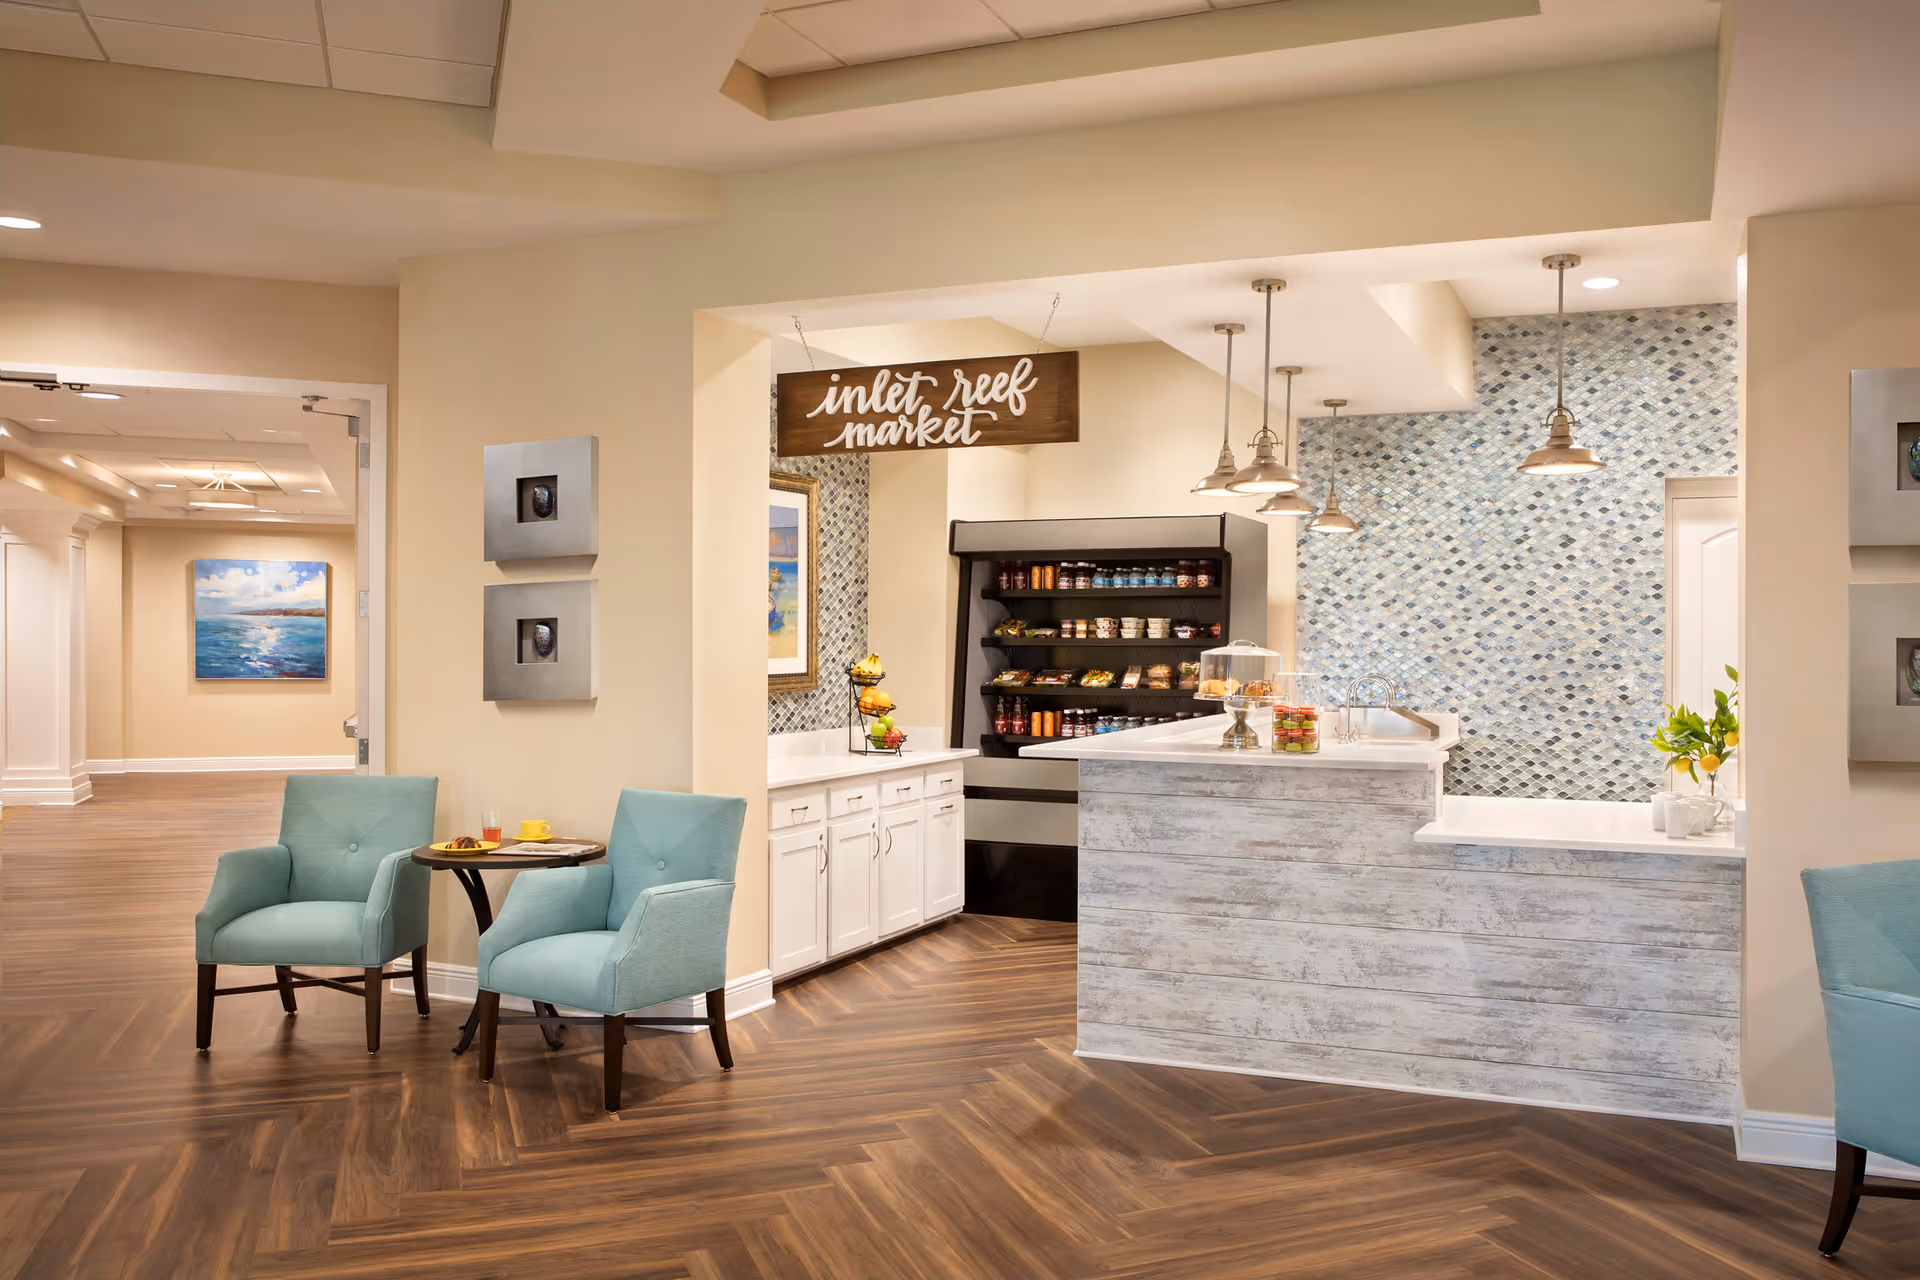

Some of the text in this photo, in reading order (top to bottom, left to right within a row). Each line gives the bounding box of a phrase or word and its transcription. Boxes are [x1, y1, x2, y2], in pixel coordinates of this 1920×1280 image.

[806, 357, 1039, 419] inlet reef
[823, 404, 998, 449] market
